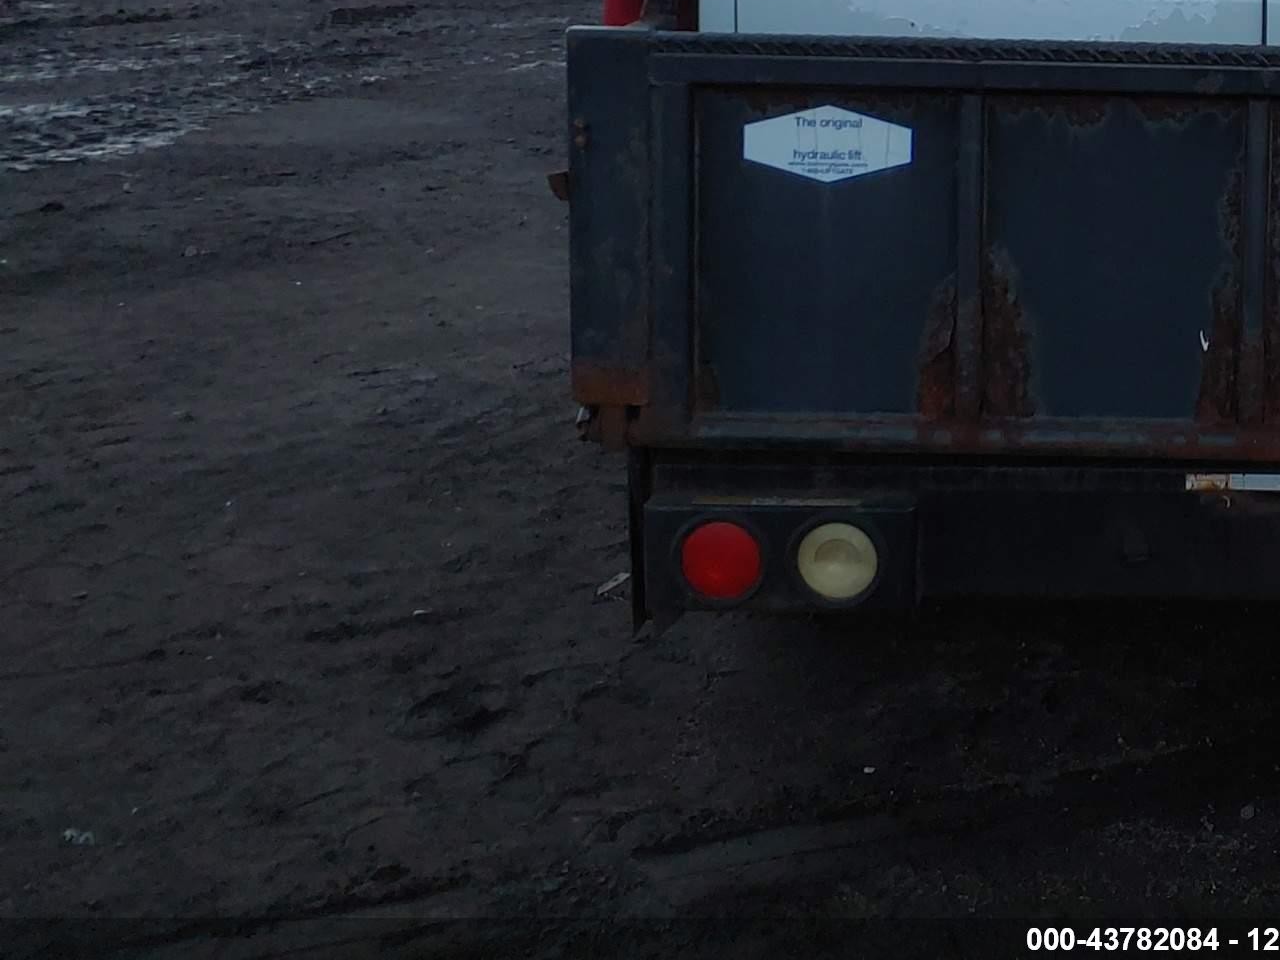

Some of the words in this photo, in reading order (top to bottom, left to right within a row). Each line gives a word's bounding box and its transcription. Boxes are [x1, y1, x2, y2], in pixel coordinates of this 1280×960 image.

[795, 117, 816, 128] The
[819, 117, 863, 130] original
[793, 149, 845, 162] hydraulic
[847, 149, 862, 160] lift
